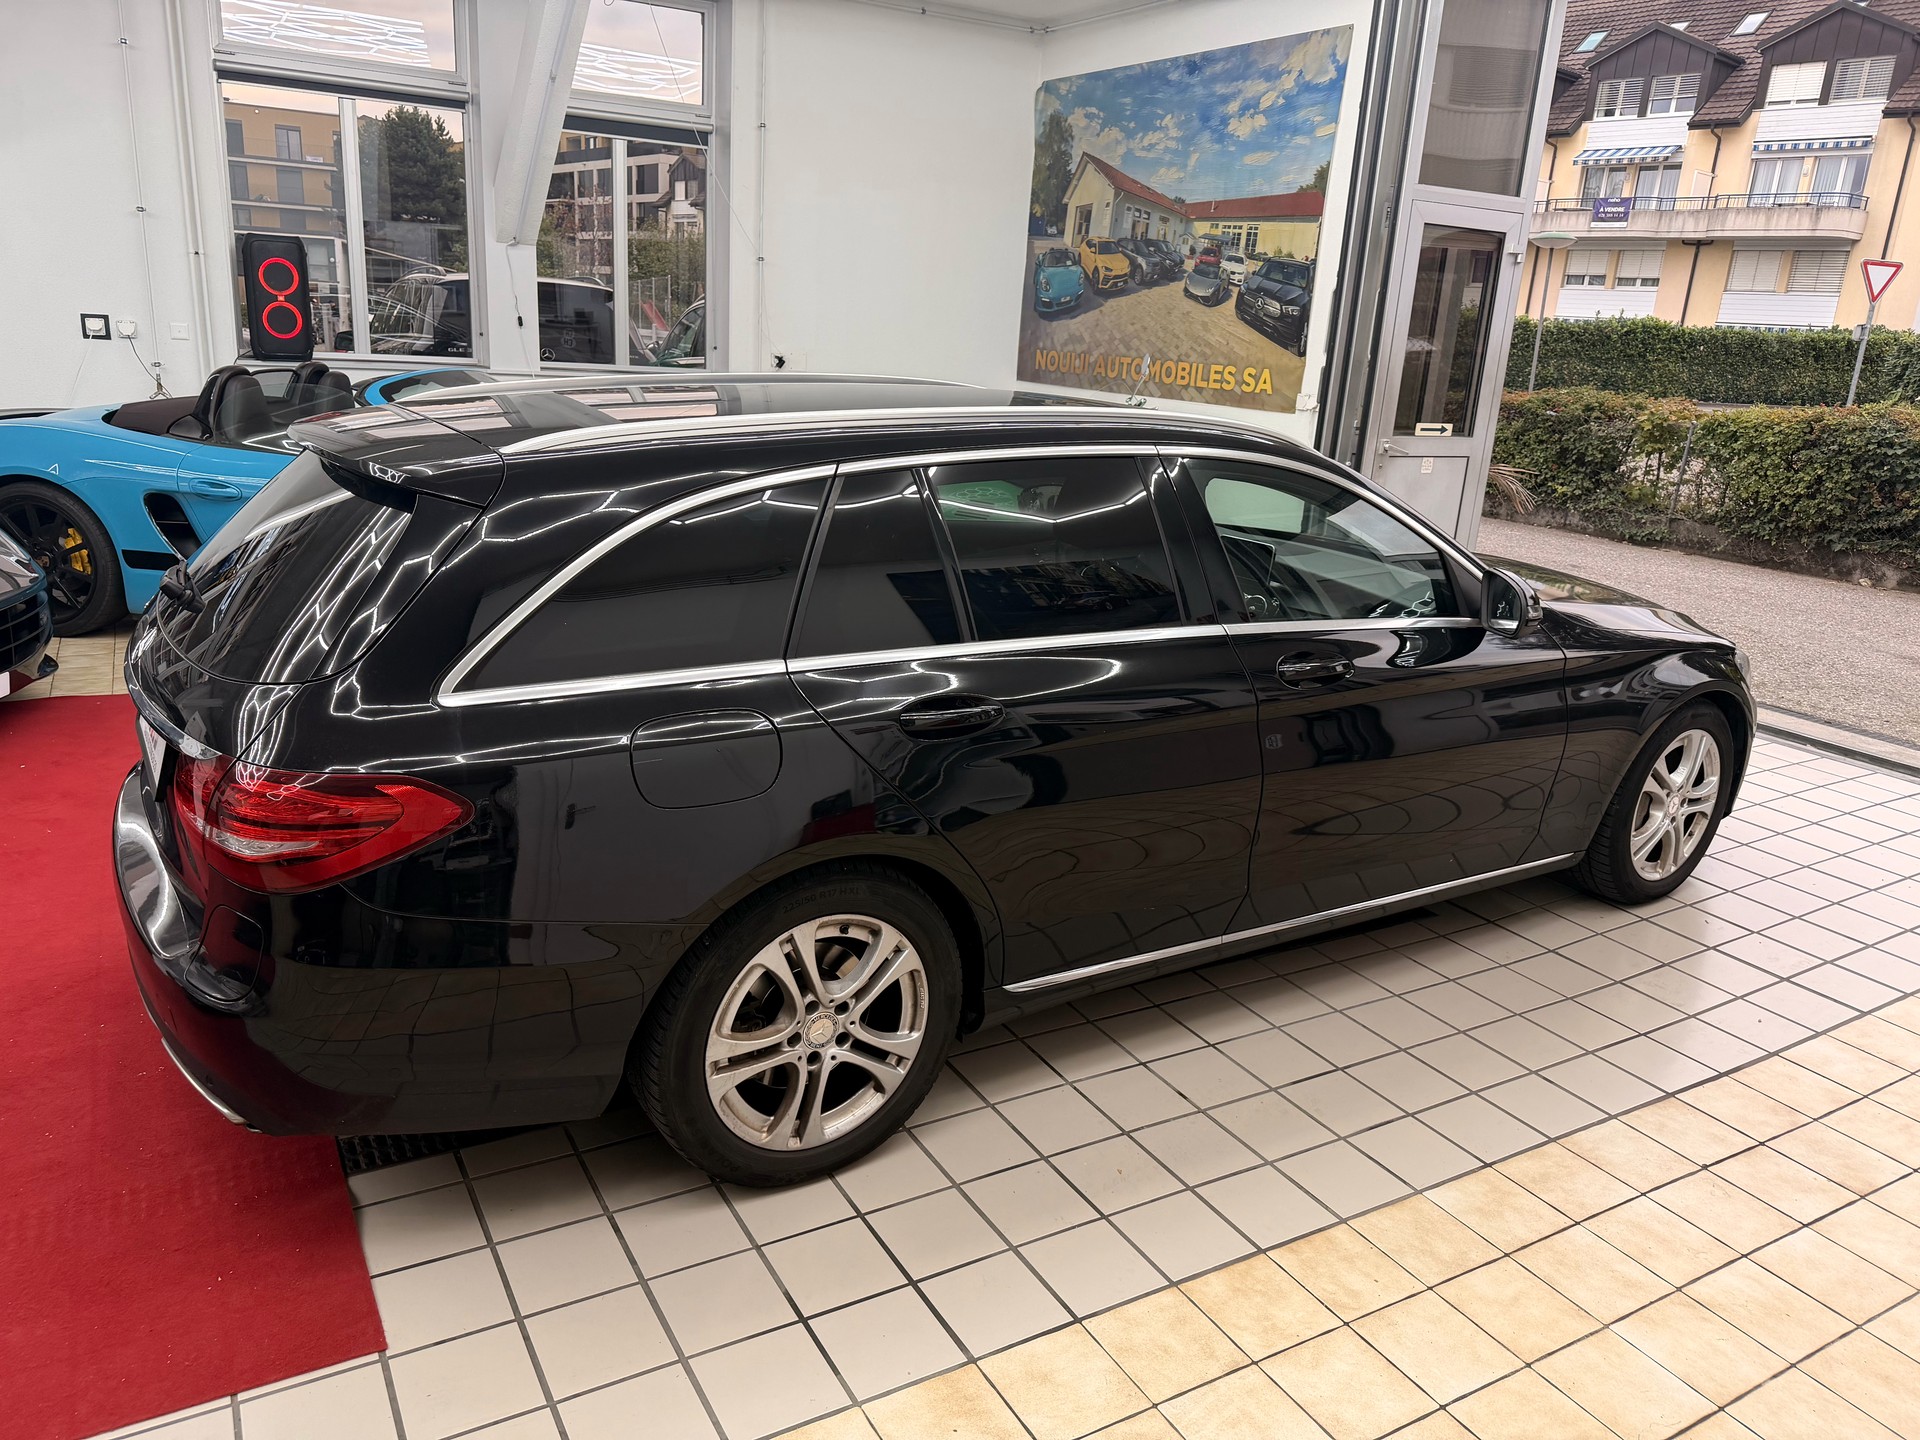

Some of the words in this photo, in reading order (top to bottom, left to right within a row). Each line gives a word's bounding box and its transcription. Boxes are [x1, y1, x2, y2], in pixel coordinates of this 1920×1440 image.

[1035, 349, 1090, 374] NOUIJI
[1093, 354, 1237, 391] AUTOMOBILES
[1241, 366, 1273, 394] SA
